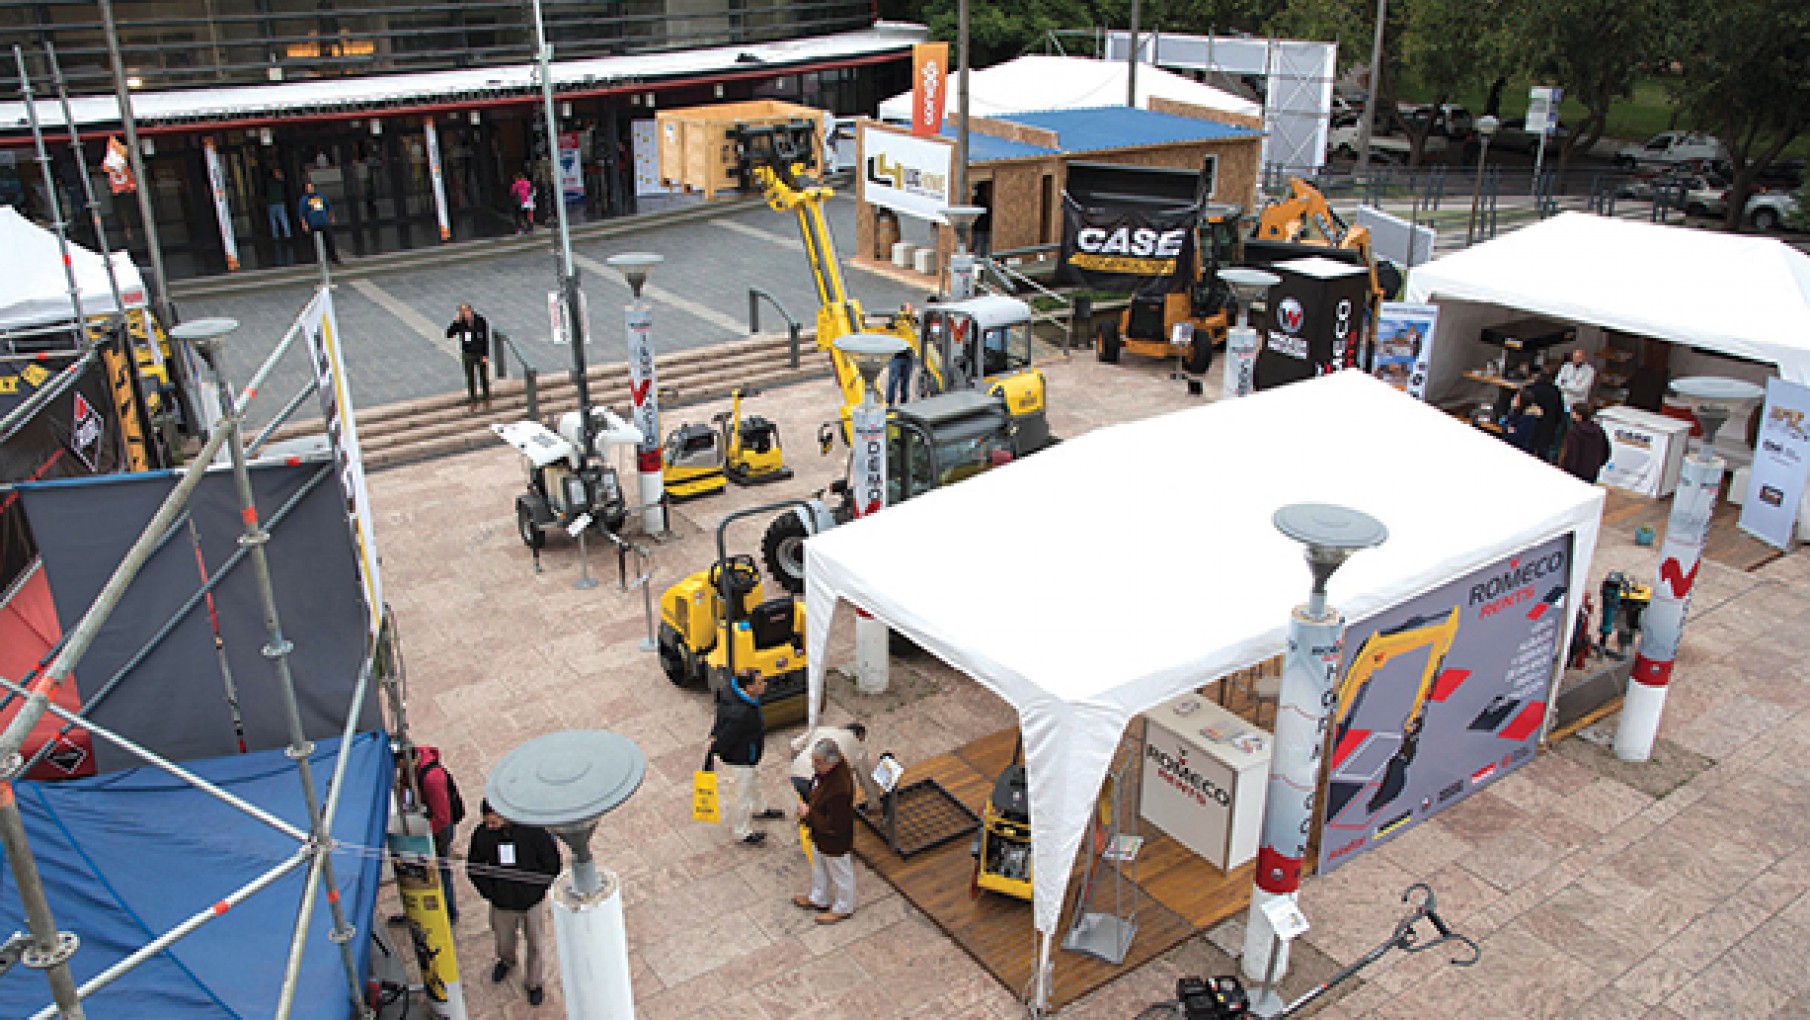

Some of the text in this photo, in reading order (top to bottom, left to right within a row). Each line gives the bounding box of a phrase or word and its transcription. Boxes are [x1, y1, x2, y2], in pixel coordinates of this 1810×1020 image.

[1078, 227, 1186, 256] CASE
[1469, 551, 1564, 608] ROMECO
[1478, 584, 1536, 620] RENTS
[1146, 743, 1230, 807] ROMECO
